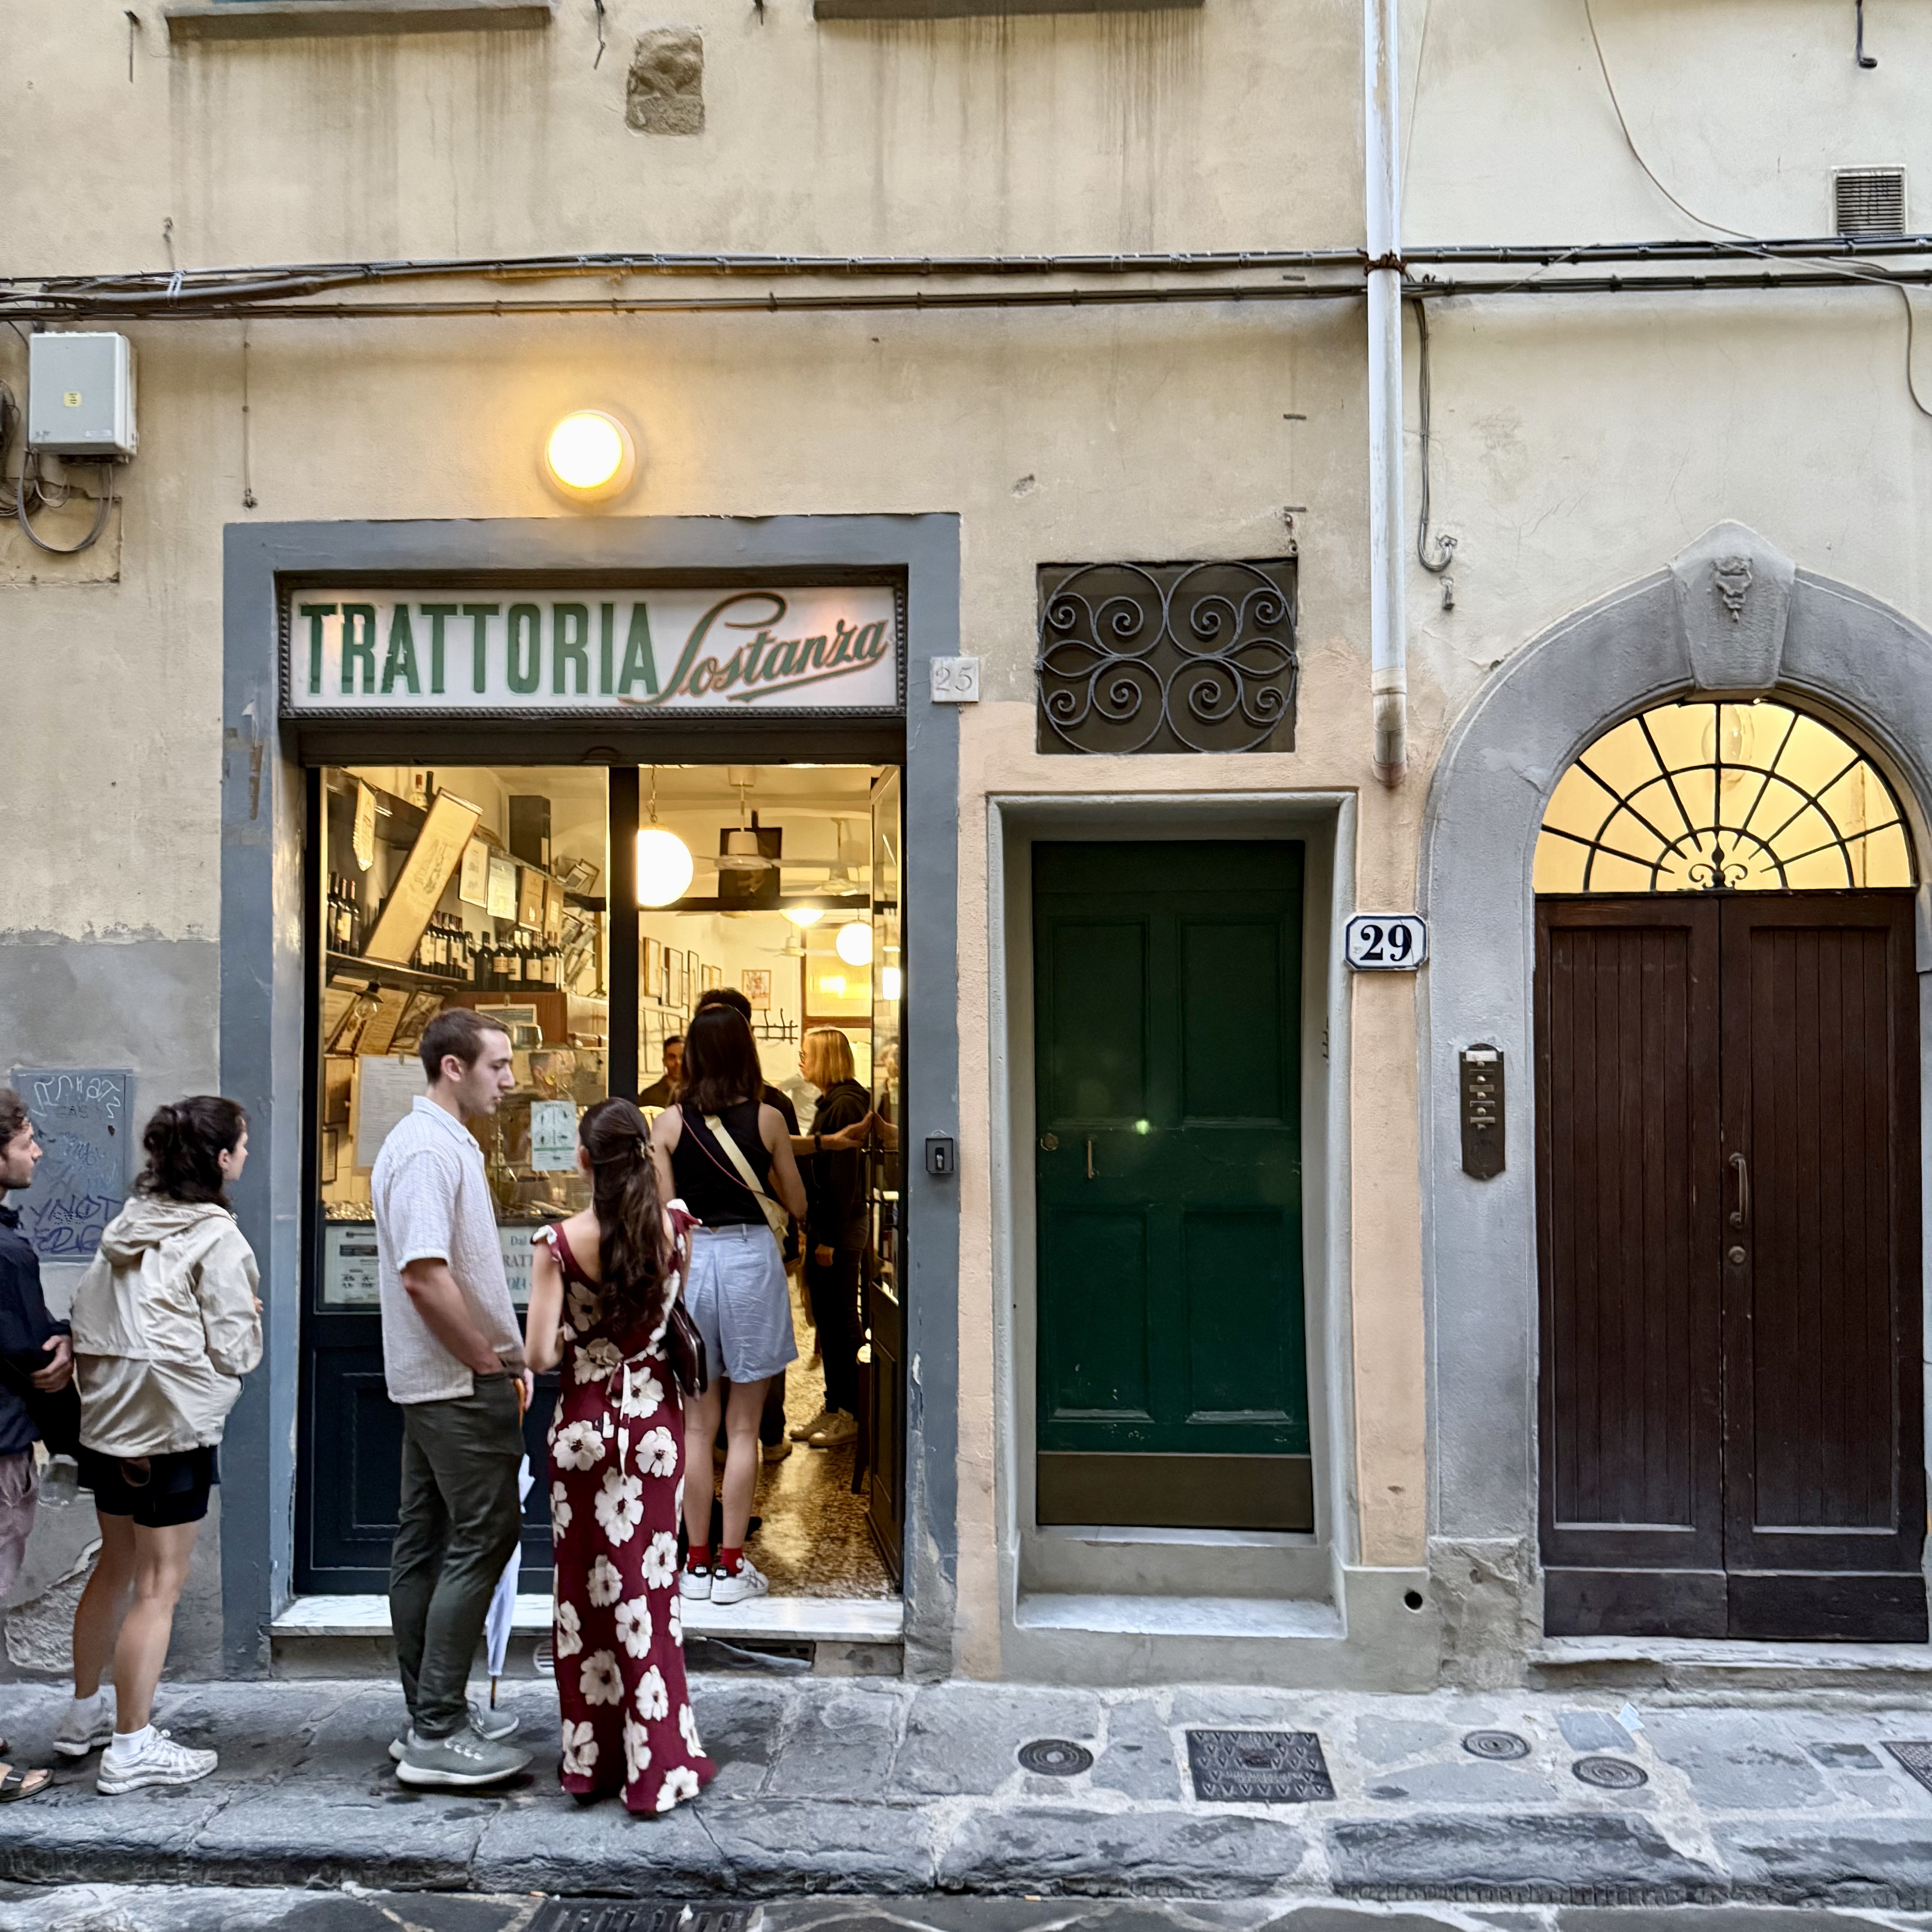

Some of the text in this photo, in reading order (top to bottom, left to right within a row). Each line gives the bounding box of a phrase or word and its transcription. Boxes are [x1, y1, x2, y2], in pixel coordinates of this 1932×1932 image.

[299, 602, 660, 696] TRATTORIA
[936, 665, 973, 692] 25
[1360, 924, 1412, 962] 29
